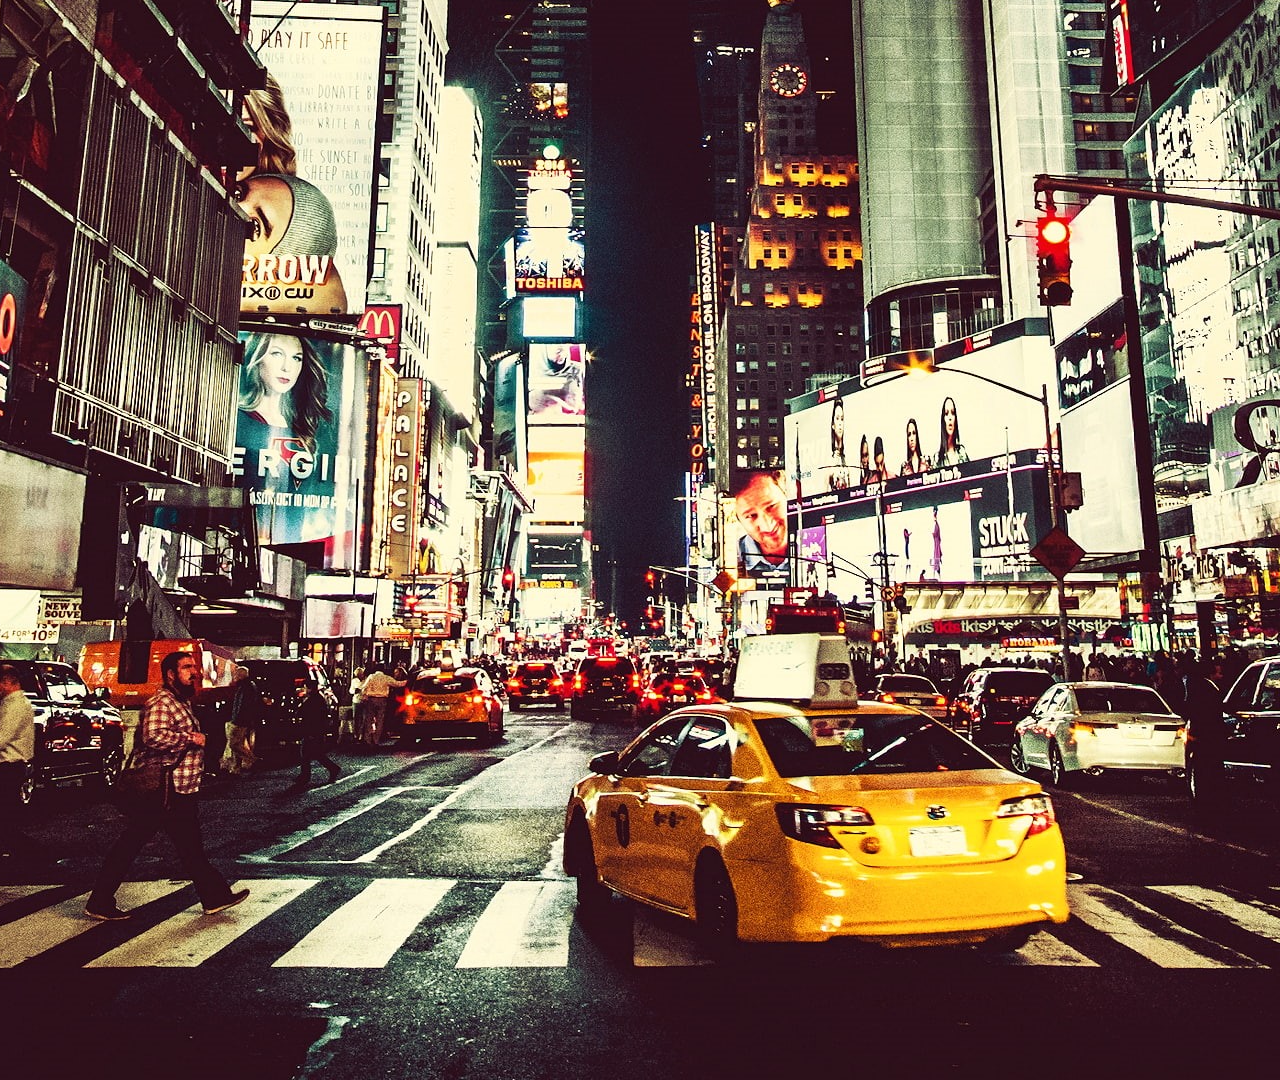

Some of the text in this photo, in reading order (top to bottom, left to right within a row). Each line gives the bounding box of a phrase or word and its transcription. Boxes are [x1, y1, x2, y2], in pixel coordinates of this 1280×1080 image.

[261, 29, 348, 50] PLAY IT SAFE
[318, 84, 360, 100] DONATE
[299, 101, 334, 113] LIBRARY
[317, 118, 348, 130] WRITE
[320, 151, 359, 164] SUNSET
[304, 165, 338, 182] SHEEP
[700, 230, 713, 302] BROADWAY
[516, 277, 583, 289] TOSHIBA
[285, 288, 314, 299] CW
[702, 304, 714, 325] ON
[690, 293, 702, 376] ERNST
[704, 324, 716, 371] SOLEIL
[706, 373, 716, 393] DU
[390, 390, 413, 533] PALACE
[276, 492, 294, 506] OCT
[979, 512, 1030, 548] STUCK
[45, 602, 70, 611] NEW
[1, 629, 10, 640] 4
[934, 619, 961, 634] tkts
